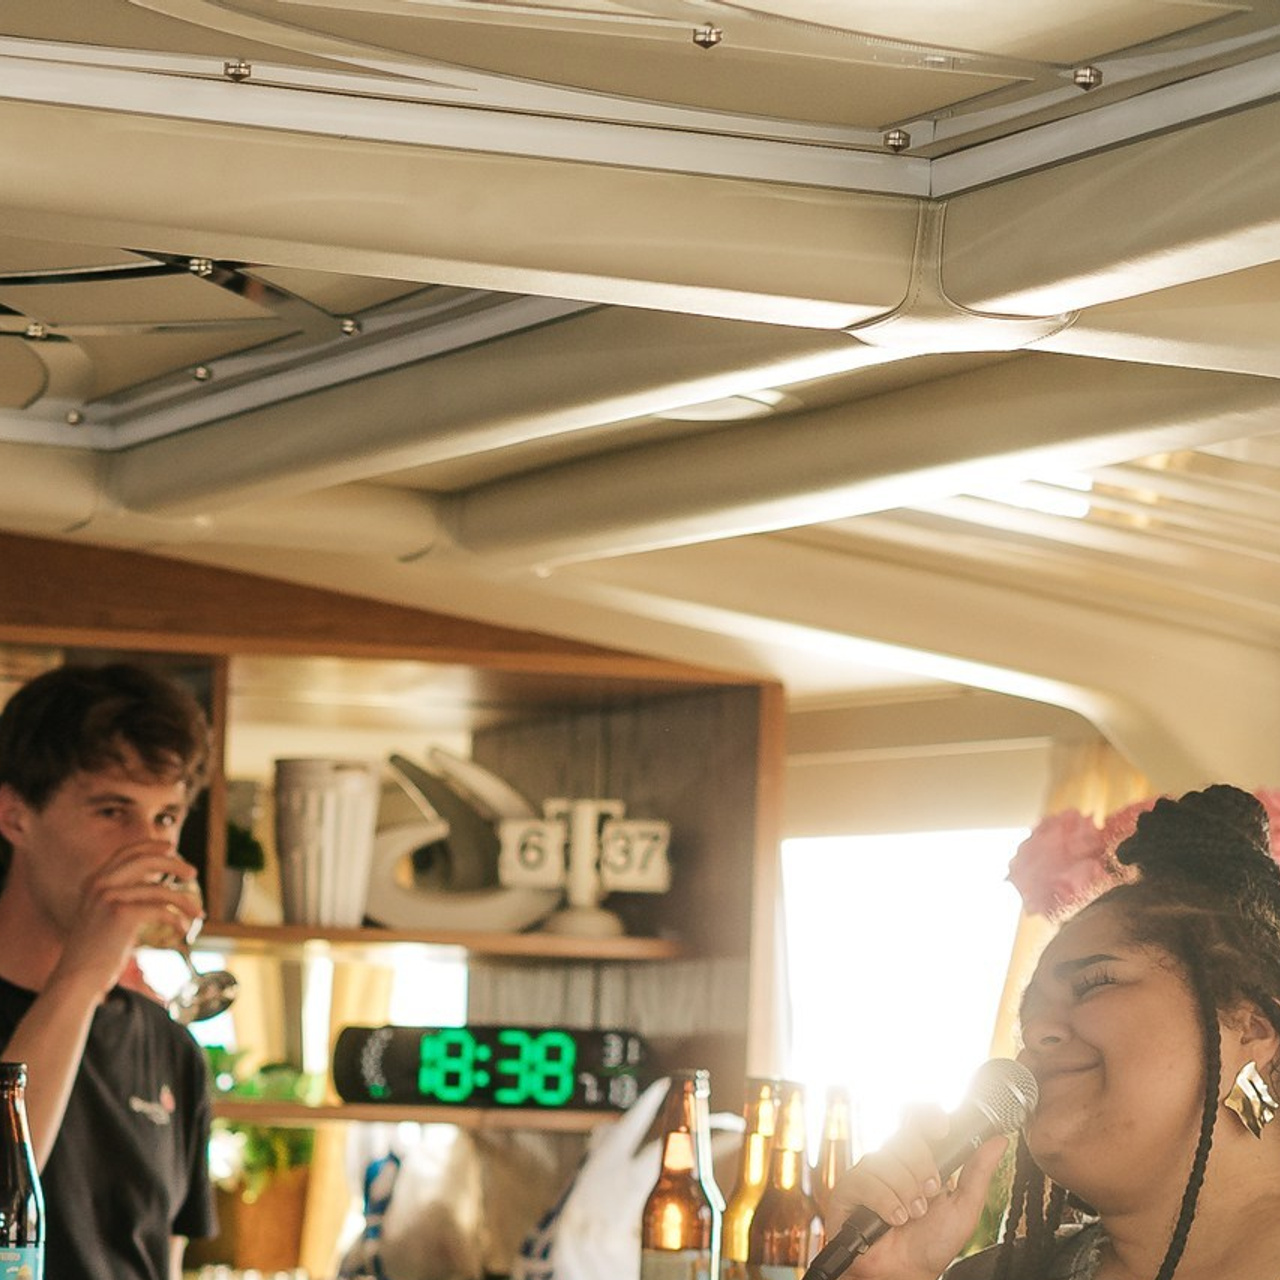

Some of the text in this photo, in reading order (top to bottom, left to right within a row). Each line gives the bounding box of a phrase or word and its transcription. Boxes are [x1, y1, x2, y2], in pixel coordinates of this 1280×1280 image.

[520, 827, 661, 875] 6 37
[418, 1027, 577, 1105] 18:38
